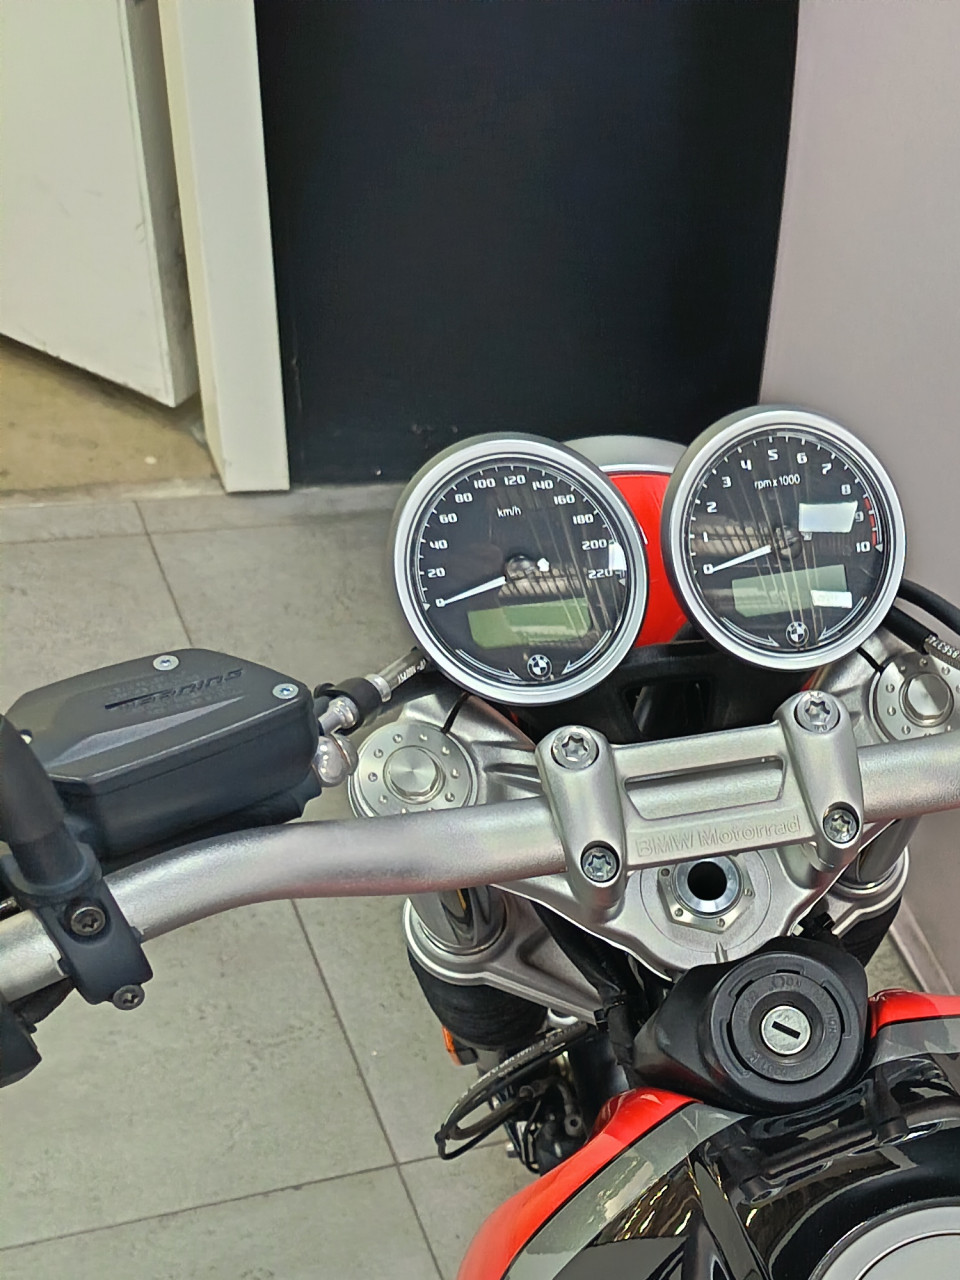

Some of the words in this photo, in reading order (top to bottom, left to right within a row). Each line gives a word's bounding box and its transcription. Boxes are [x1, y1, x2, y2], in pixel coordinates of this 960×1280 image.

[768, 450, 778, 460] 5
[797, 453, 807, 463] 6
[741, 460, 752, 470] 4
[822, 464, 832, 474] 7
[473, 478, 495, 489] 100
[504, 475, 526, 485] 120
[532, 480, 554, 490] 140
[722, 476, 732, 488] 3
[754, 480, 772, 490] rpm
[779, 474, 800, 485] 1000
[841, 484, 851, 495] 8
[455, 492, 473, 503] 80
[554, 494, 575, 504] 160
[497, 505, 522, 517] km/h
[706, 502, 717, 512] 2
[439, 513, 458, 524] 60
[573, 514, 594, 524] 180
[703, 532, 708, 542] 1
[430, 539, 448, 550] 40
[582, 540, 607, 551] 200
[856, 542, 871, 552] 10
[428, 568, 446, 578] 20
[703, 564, 714, 574] 0
[588, 569, 612, 580] 220
[435, 597, 446, 608] 0
[635, 832, 694, 858] BMW
[698, 815, 801, 847] Motorrad
